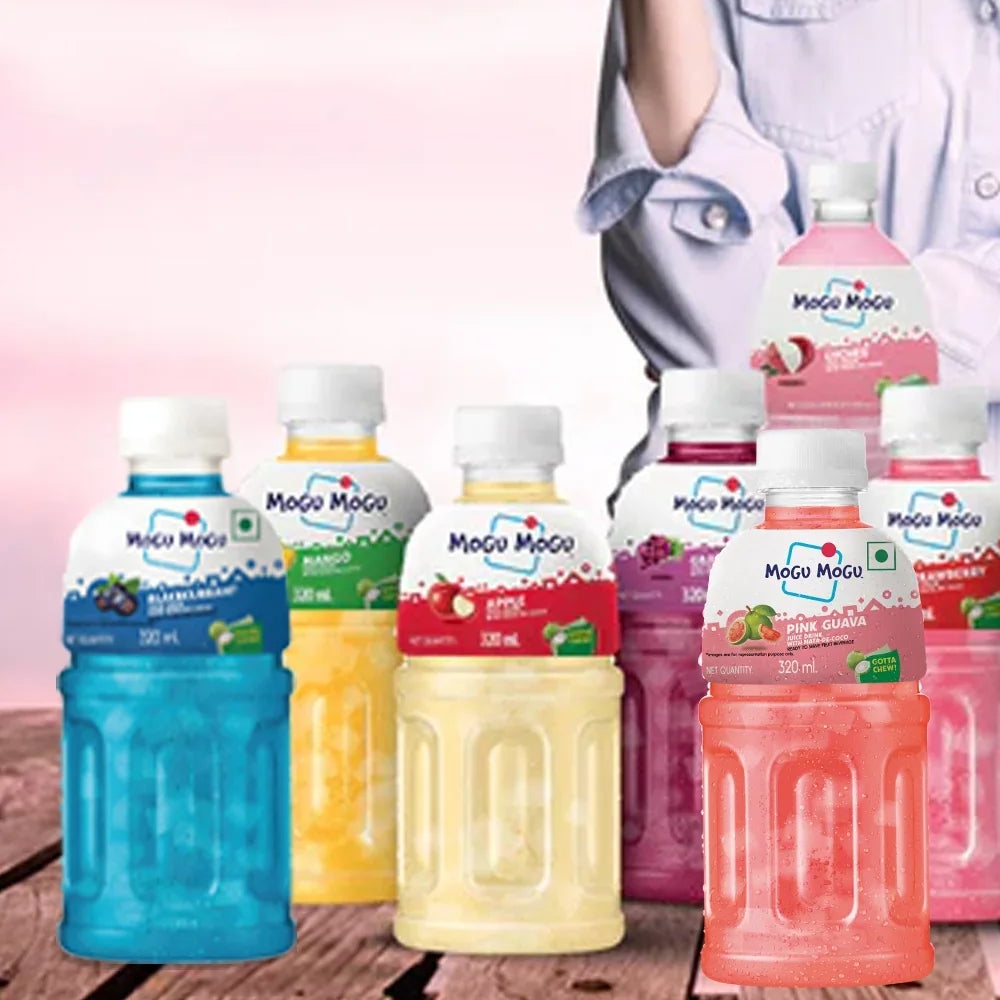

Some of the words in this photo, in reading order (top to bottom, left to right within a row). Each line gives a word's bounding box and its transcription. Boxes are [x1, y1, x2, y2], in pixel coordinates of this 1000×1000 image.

[786, 621, 817, 635] PINK
[822, 616, 867, 630] GUAVA
[871, 656, 897, 665] GOTTA
[706, 666, 718, 674] NET
[778, 659, 799, 674] 320
[873, 664, 897, 673] CHEW!
